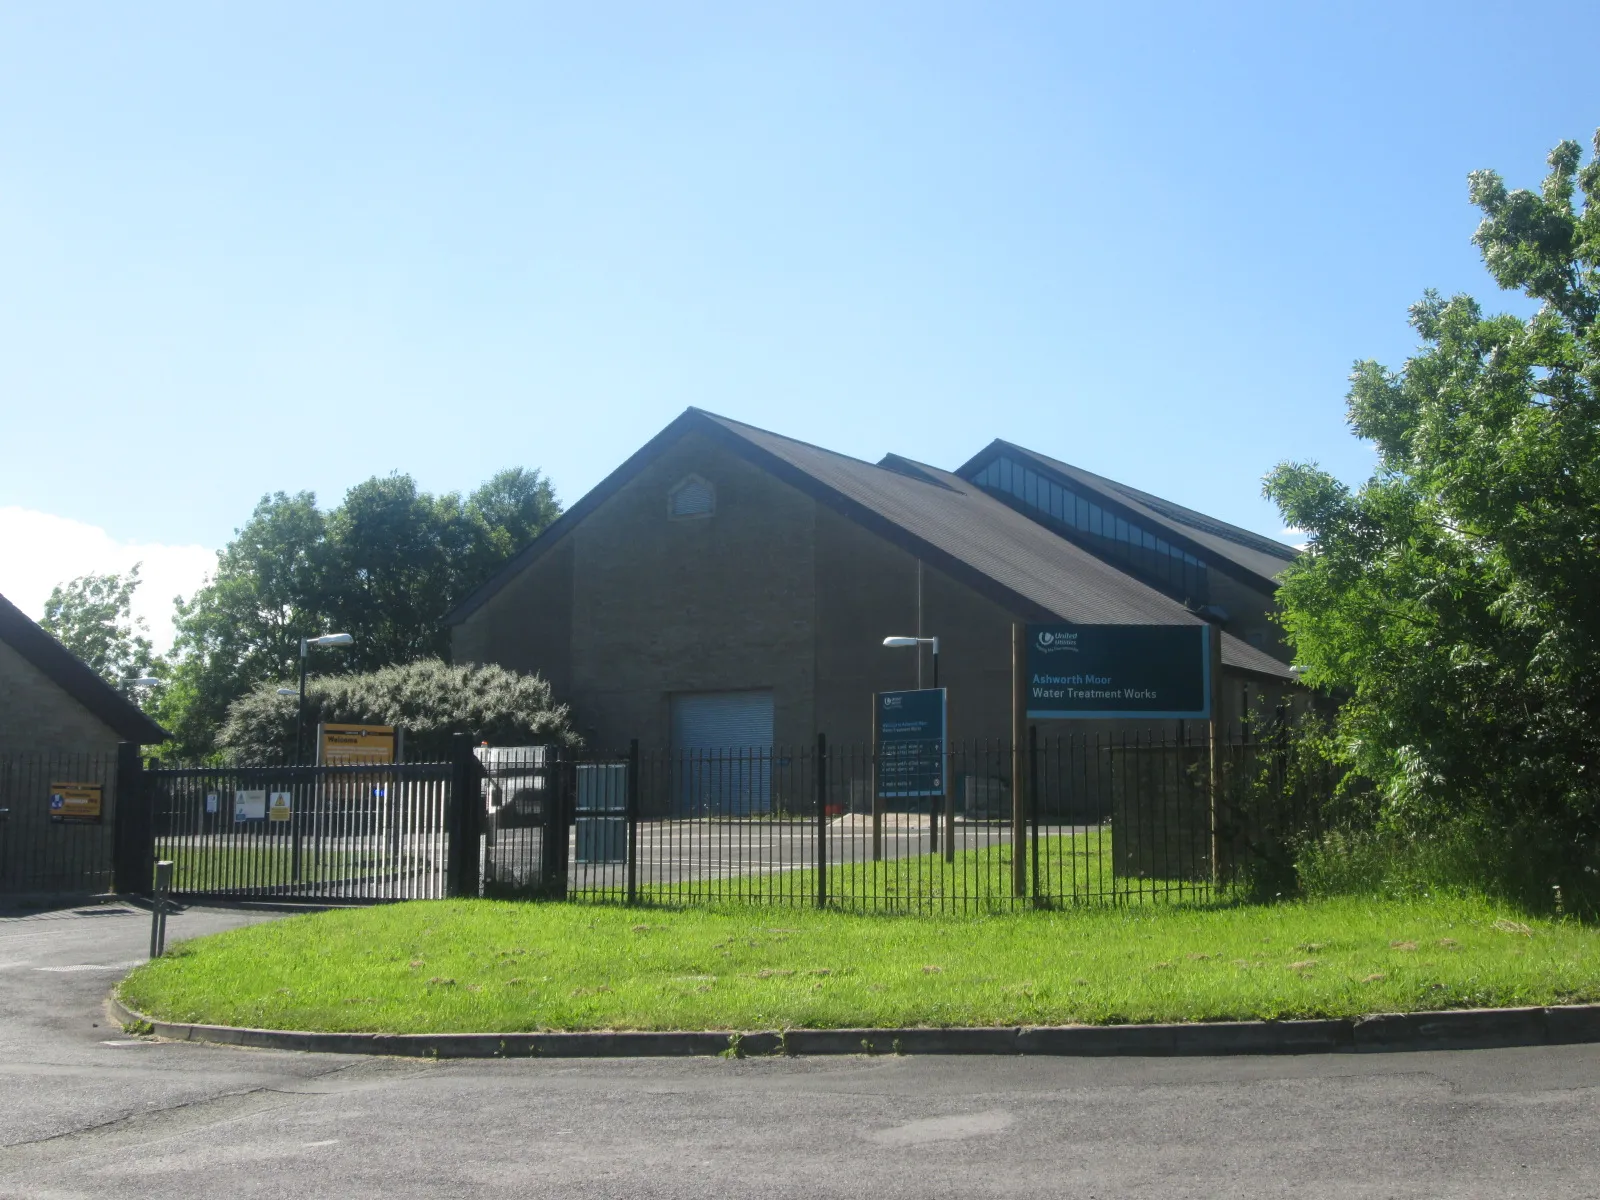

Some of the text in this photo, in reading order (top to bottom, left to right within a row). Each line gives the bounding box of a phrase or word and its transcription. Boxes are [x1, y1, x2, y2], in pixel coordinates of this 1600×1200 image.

[1033, 674, 1112, 684] Ashworth Moor
[1033, 687, 1157, 699] Water Treatment Works
[328, 736, 358, 744] Welcome
